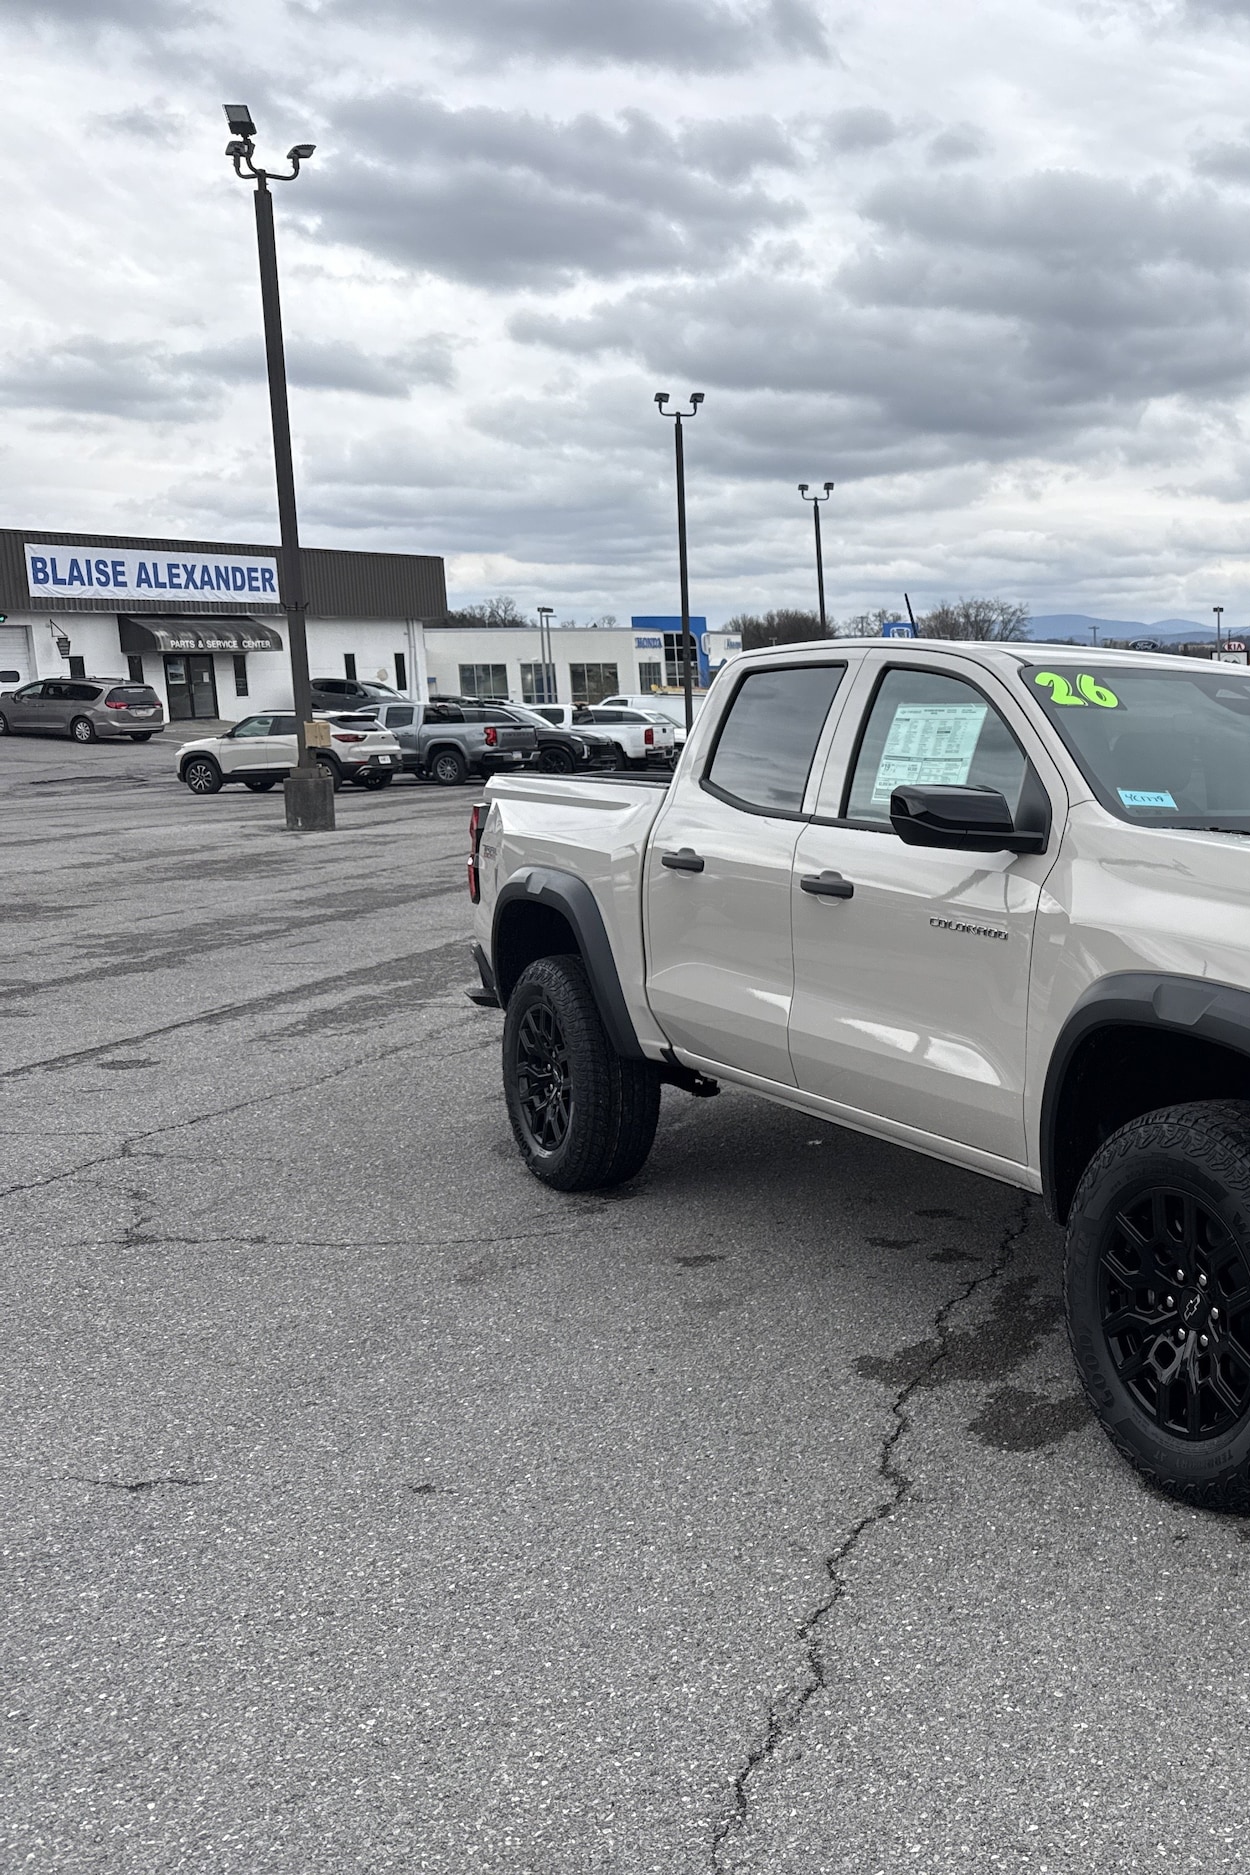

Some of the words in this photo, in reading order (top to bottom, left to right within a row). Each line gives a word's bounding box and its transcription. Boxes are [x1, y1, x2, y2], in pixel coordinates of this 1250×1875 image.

[30, 556, 128, 588] BLAISE
[136, 562, 277, 593] ALEXANDER
[170, 639, 196, 649] PARTS
[198, 640, 204, 649] &
[206, 640, 239, 649] SERVICE
[241, 639, 272, 649] CENTER
[1227, 643, 1243, 651] KIA
[1034, 672, 1119, 709] 26
[929, 916, 1009, 941] COLORADO
